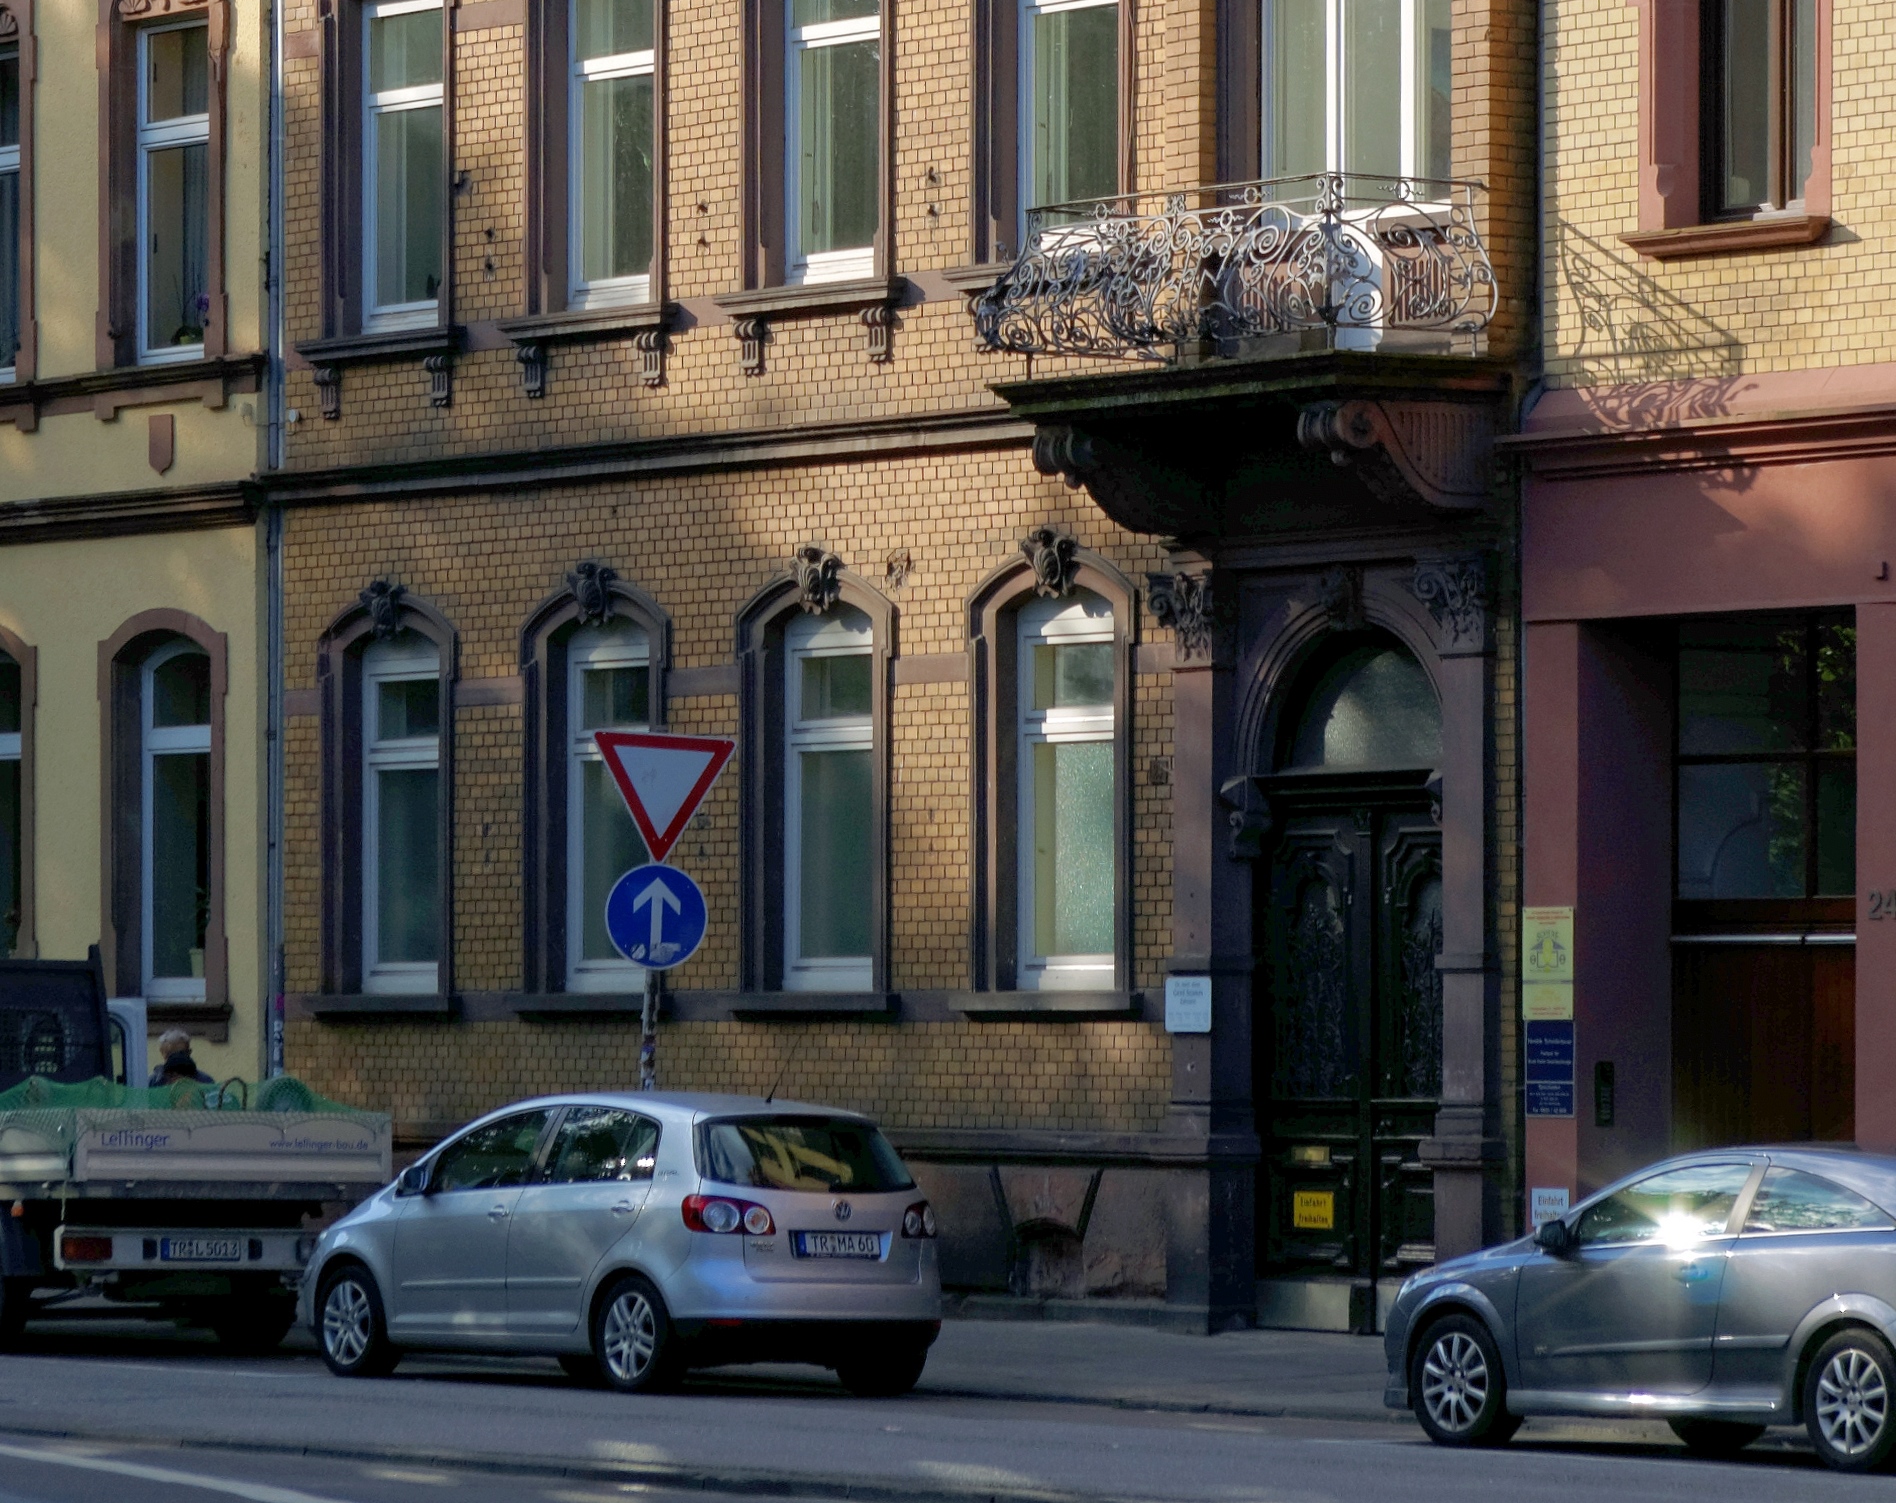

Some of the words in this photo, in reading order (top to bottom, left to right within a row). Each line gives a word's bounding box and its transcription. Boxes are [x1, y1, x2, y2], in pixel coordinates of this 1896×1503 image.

[1538, 1195, 1564, 1206] Einfahrt
[810, 1235, 828, 1252] TR
[858, 1235, 875, 1252] 60
